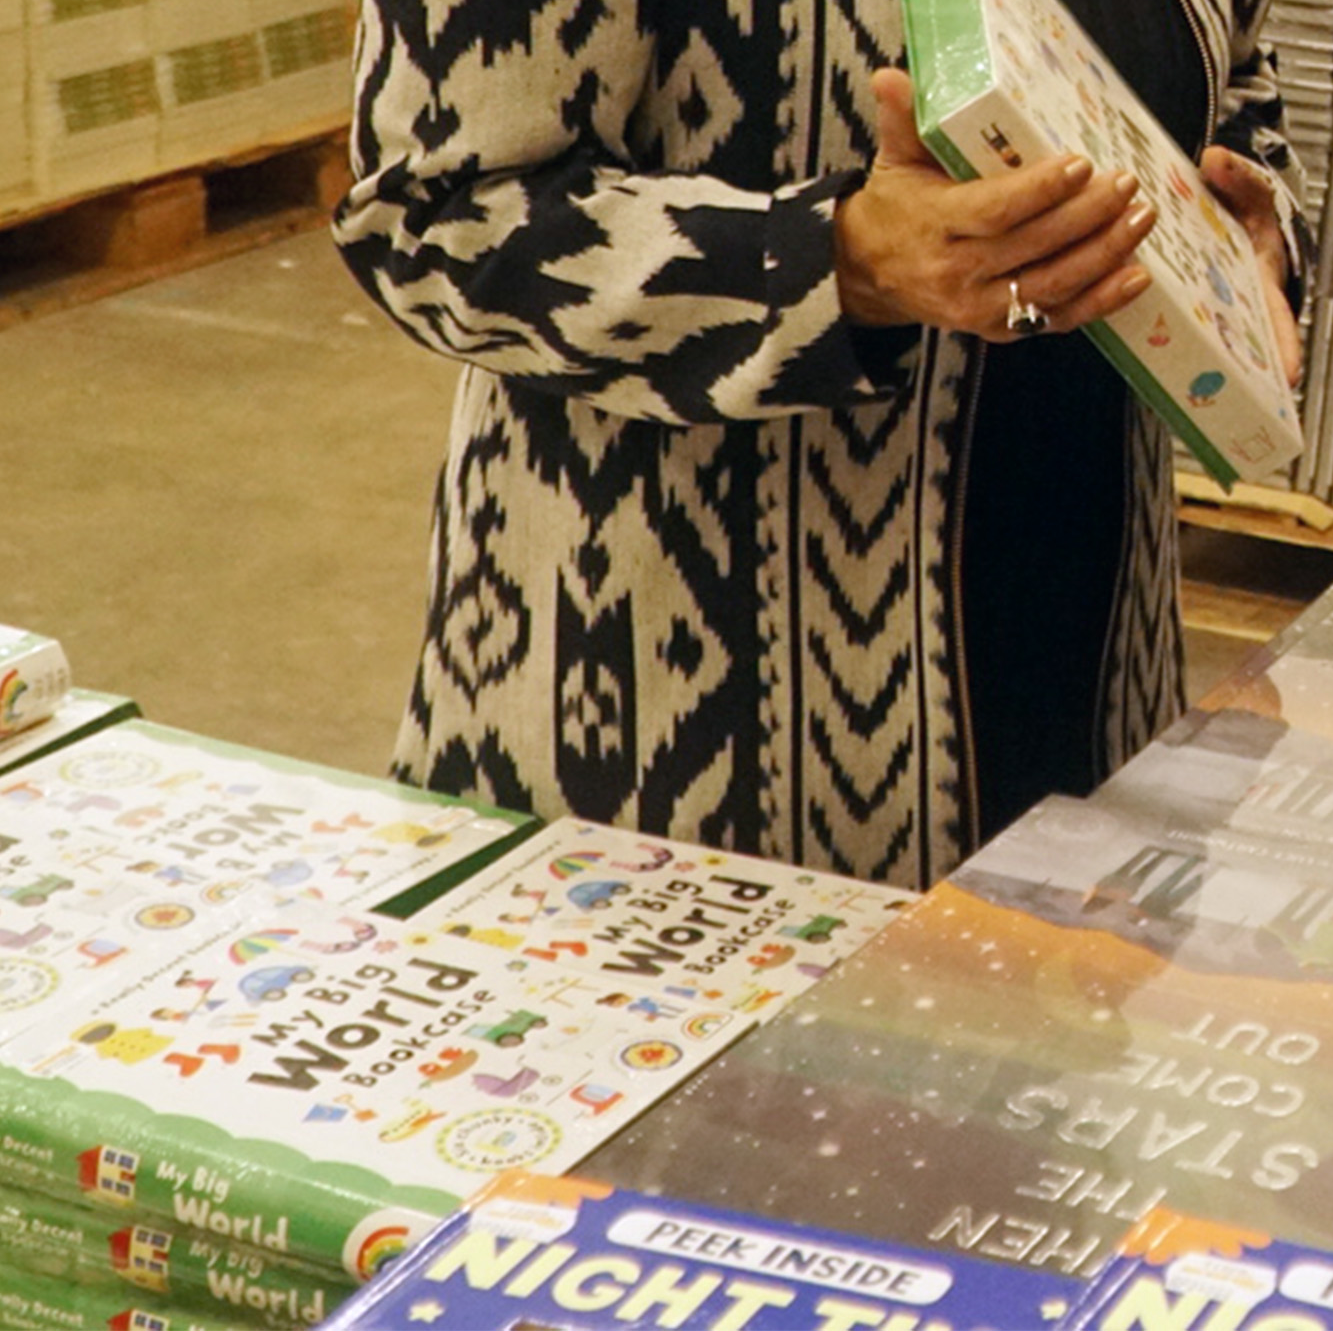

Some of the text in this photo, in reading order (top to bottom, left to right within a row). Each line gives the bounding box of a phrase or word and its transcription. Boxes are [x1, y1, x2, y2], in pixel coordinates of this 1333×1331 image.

[592, 877, 703, 946] My Big
[600, 874, 776, 977] World
[683, 898, 796, 976] Bookcase
[246, 957, 480, 1092] World
[250, 963, 398, 1048] My Big
[341, 989, 497, 1089] Bookcase
[1170, 1012, 1321, 1066] OUT
[1116, 1049, 1305, 1118] COME
[997, 1084, 1320, 1191] STARS
[156, 1160, 230, 1204] My Big
[1014, 1159, 1169, 1222] THE
[172, 1193, 289, 1252] World
[189, 1242, 219, 1267] My
[644, 1220, 922, 1295] PEEK INSIDE
[927, 1204, 1101, 1278] HEN
[206, 1270, 326, 1324] World
[424, 1229, 797, 1331] NIGHT
